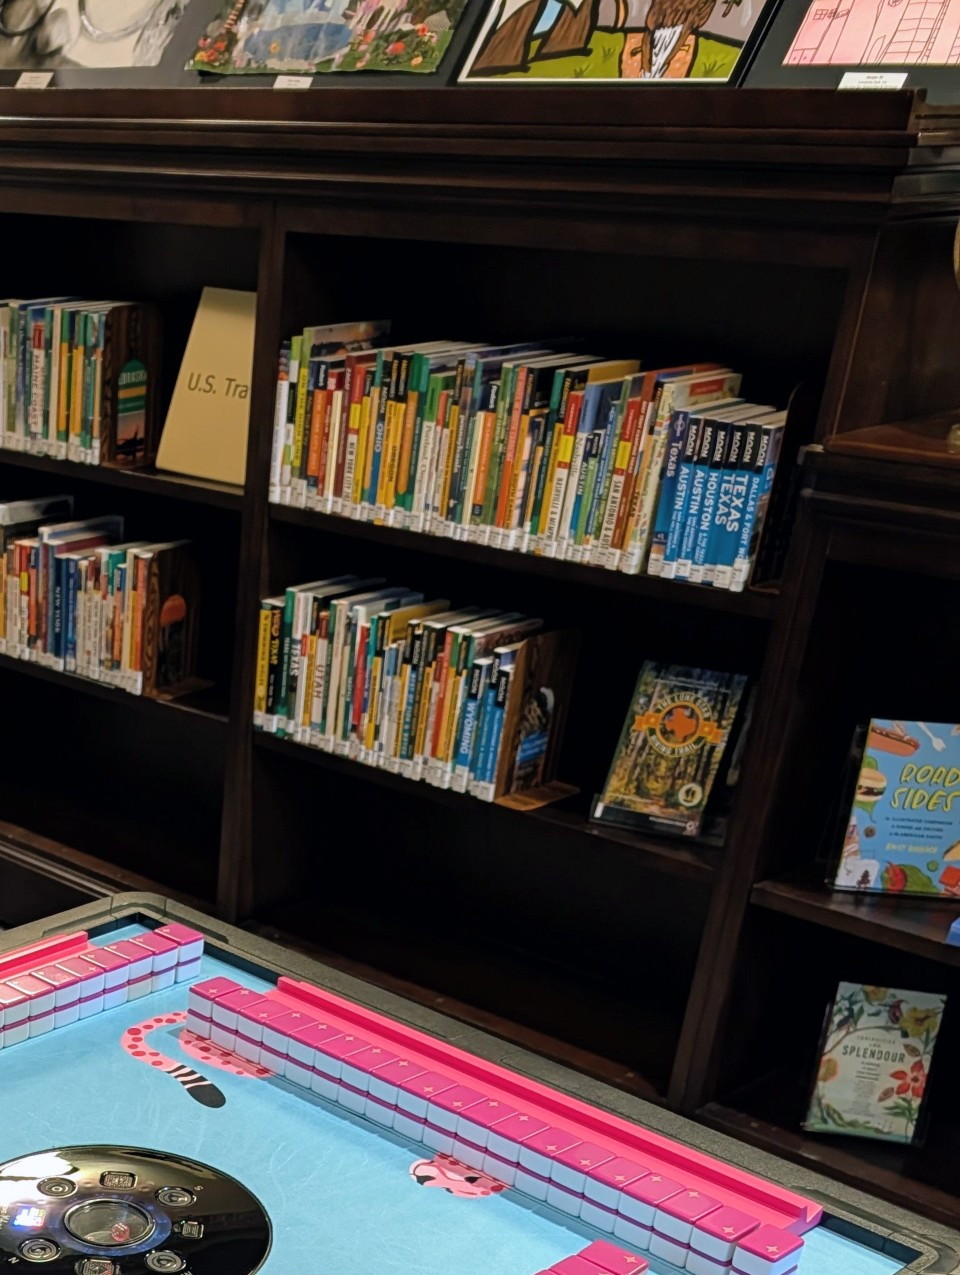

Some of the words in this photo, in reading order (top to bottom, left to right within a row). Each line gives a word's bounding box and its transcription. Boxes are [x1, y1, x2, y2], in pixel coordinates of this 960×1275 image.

[187, 372, 216, 394] U.S.
[225, 377, 249, 399] Tra
[376, 423, 384, 453] OHIO
[685, 425, 698, 456] MOON
[700, 426, 713, 458] MOON
[713, 430, 726, 462] MOON
[728, 431, 742, 463] MOON
[742, 431, 756, 463] MOON
[756, 435, 769, 467] MOON
[667, 440, 683, 478] Texas
[578, 461, 588, 495] AUSTIN
[674, 466, 690, 510] AUSTIN
[689, 469, 705, 515] AUSTIN
[700, 472, 719, 531] HOUSTON
[715, 474, 736, 526] TEXAS
[726, 474, 750, 533] TEXAS
[746, 477, 760, 512] DALLAS
[608, 495, 620, 527] ANTONIO
[741, 521, 752, 546] FORT
[290, 644, 301, 677] TEXAS
[491, 659, 500, 684] MOON
[315, 664, 324, 699] UTAH
[471, 668, 481, 694] MOON
[497, 676, 507, 702] MOON
[460, 702, 477, 754] WYOMING
[900, 763, 960, 788] ROAD
[890, 787, 960, 812] SIDES
[842, 1044, 906, 1064] SPLENDOUR
[8, 1256, 20, 1264] N
